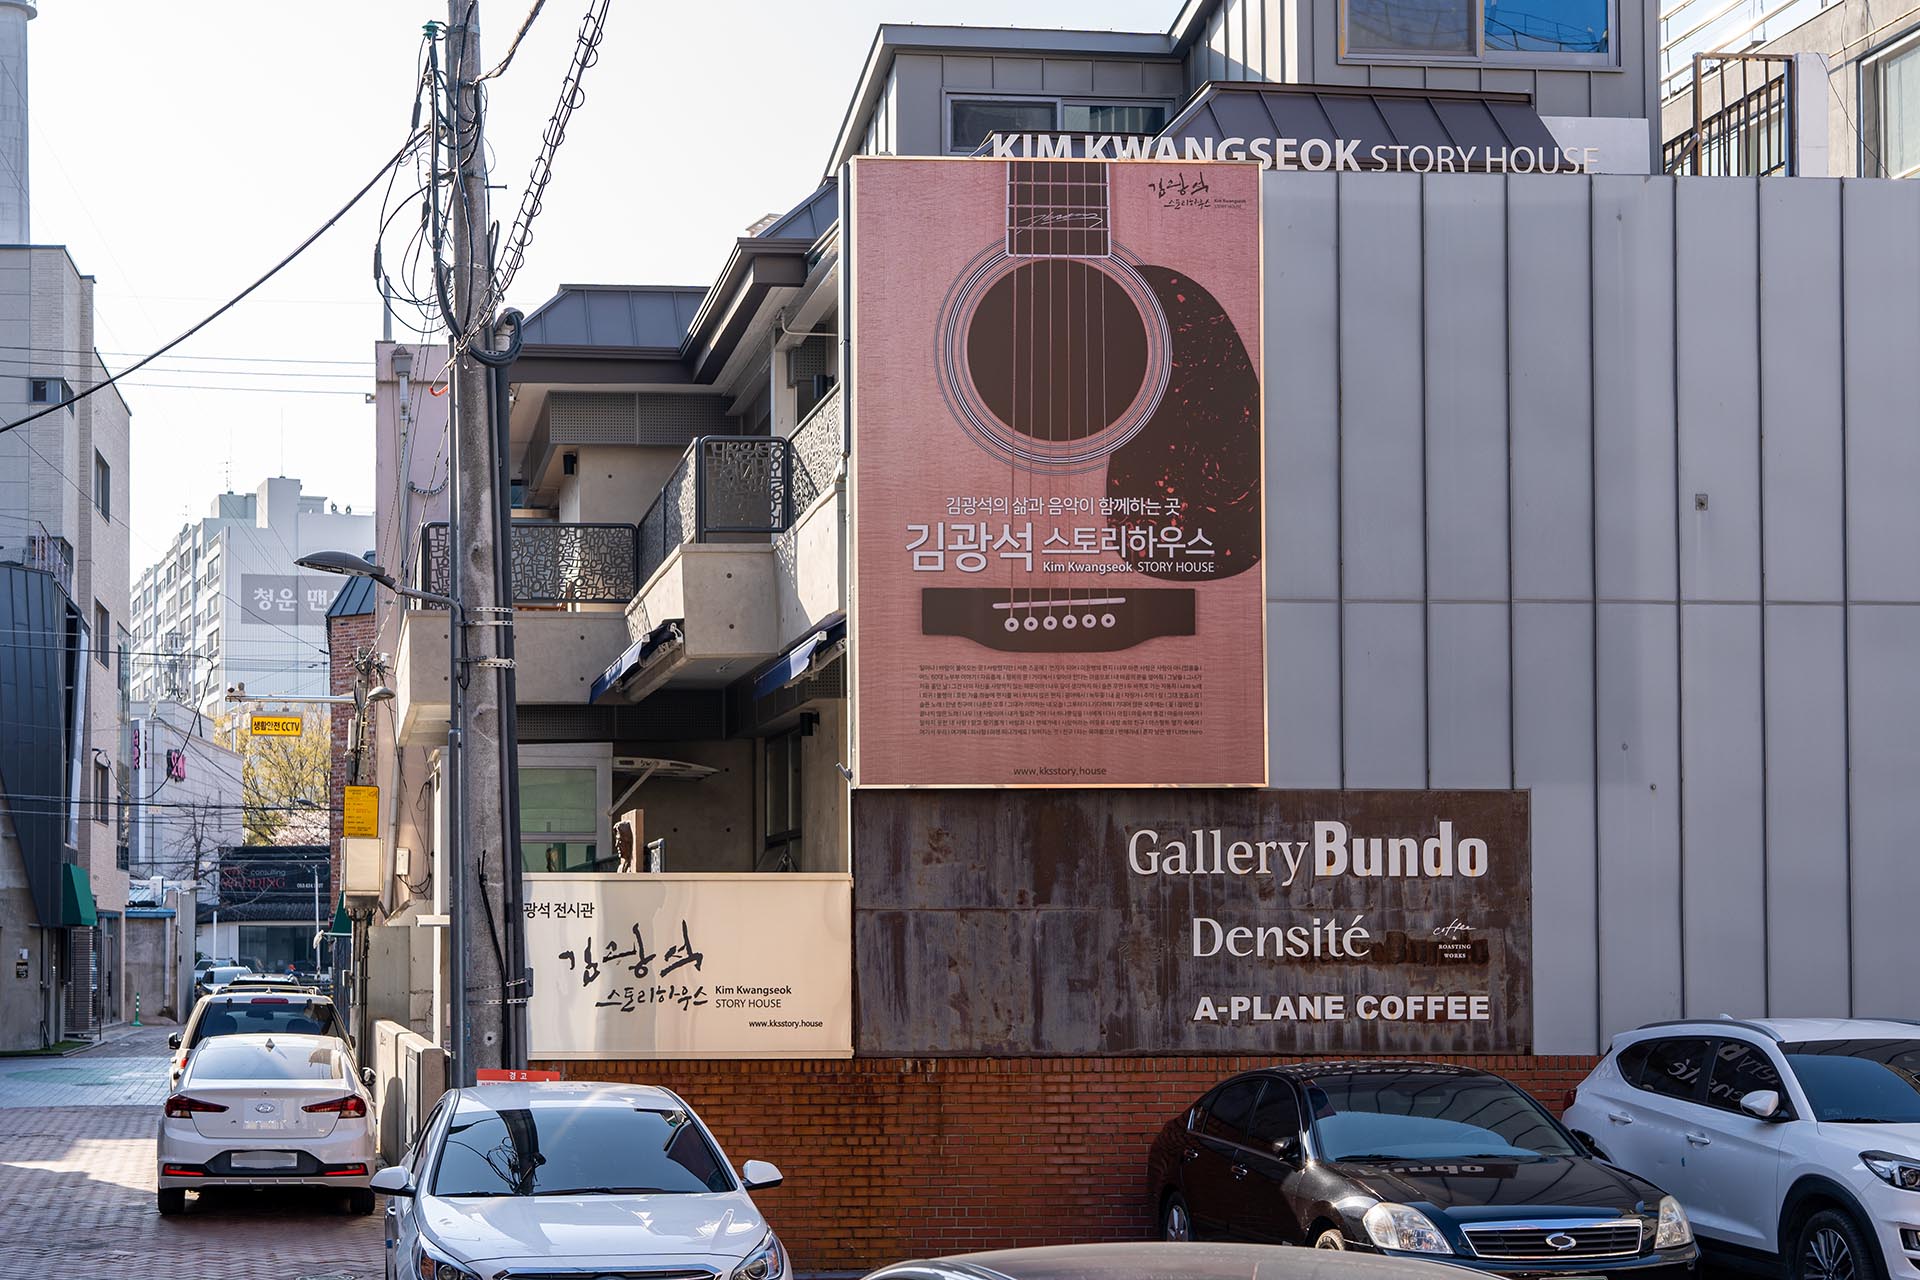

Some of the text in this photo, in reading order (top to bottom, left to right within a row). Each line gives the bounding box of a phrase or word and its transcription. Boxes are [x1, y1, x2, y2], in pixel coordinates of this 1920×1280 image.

[993, 134, 1600, 175] KIM KWANGSEOK STORY HOUSE
[946, 496, 1181, 516] 김광석의 삶과 음악이 함께하는 곳
[904, 522, 1215, 573] 김광석 스토리하우스
[1043, 561, 1215, 576] Kim Kwangseok STORY HOUSE
[253, 587, 338, 612] 청운 맨
[254, 721, 300, 731] 생활안전 CCTV
[1013, 765, 1107, 777] www.kksstory.house
[1128, 820, 1489, 888] Gallery Bundo
[523, 902, 595, 919] 광석 전시관
[1193, 914, 1371, 958] Densité
[558, 919, 703, 987] 김광석
[595, 985, 708, 1012] 스토리하우스
[715, 985, 792, 998] Kim Kwangseok
[715, 998, 781, 1009] STORY HOUSE
[1193, 995, 1489, 1021] A-PLANE COFFEE
[748, 1019, 823, 1029] www.kksstory.house
